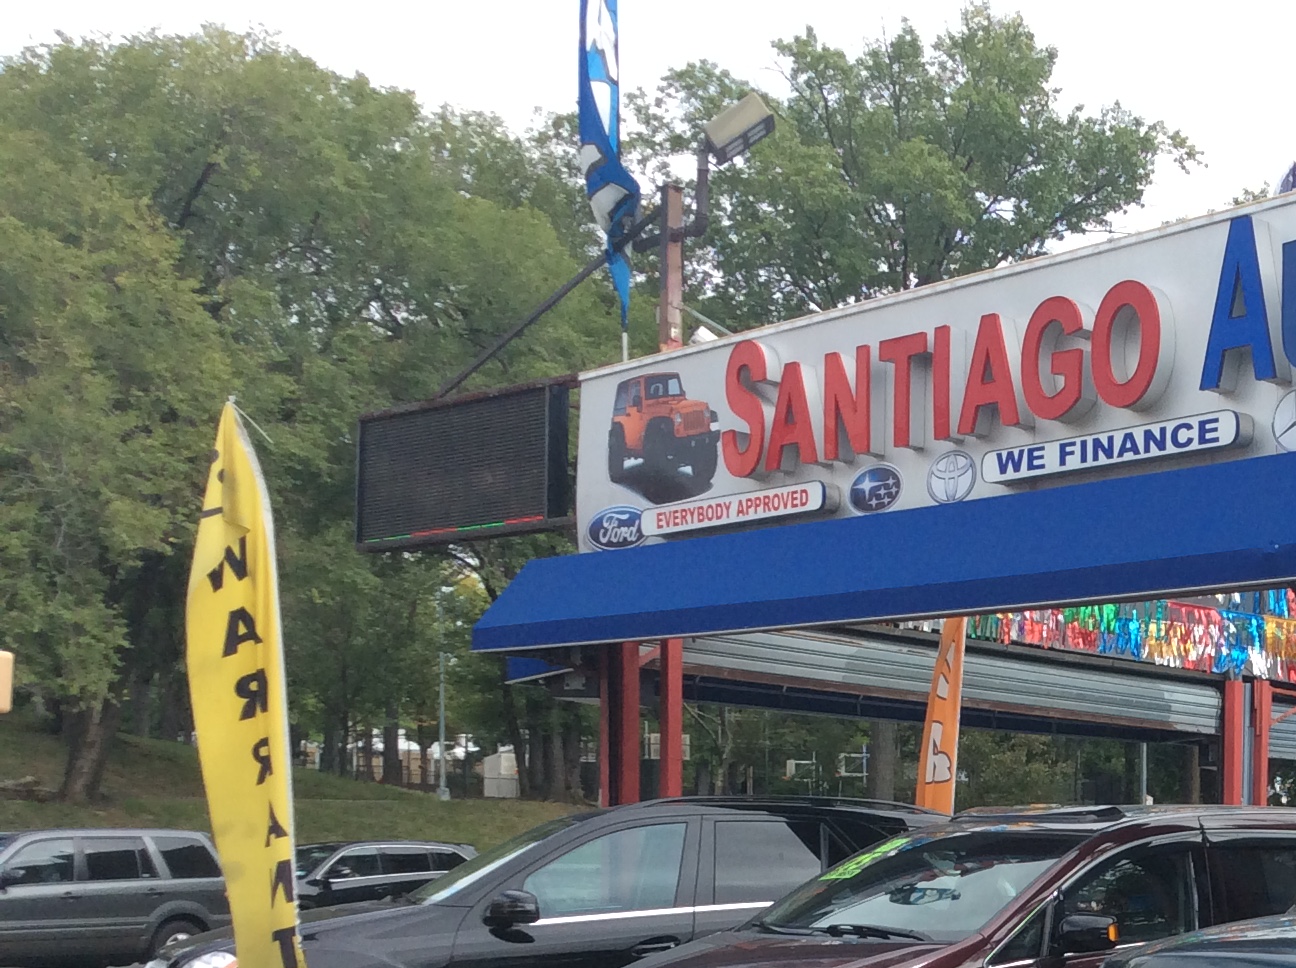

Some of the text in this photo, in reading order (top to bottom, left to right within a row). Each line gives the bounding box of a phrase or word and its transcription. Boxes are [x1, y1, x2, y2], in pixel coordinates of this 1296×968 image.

[721, 279, 1162, 478] SANTIAGO
[996, 416, 1221, 476] WE FINANCE
[598, 513, 641, 546] Ford
[655, 488, 810, 530] EVERYBODY APPROVED
